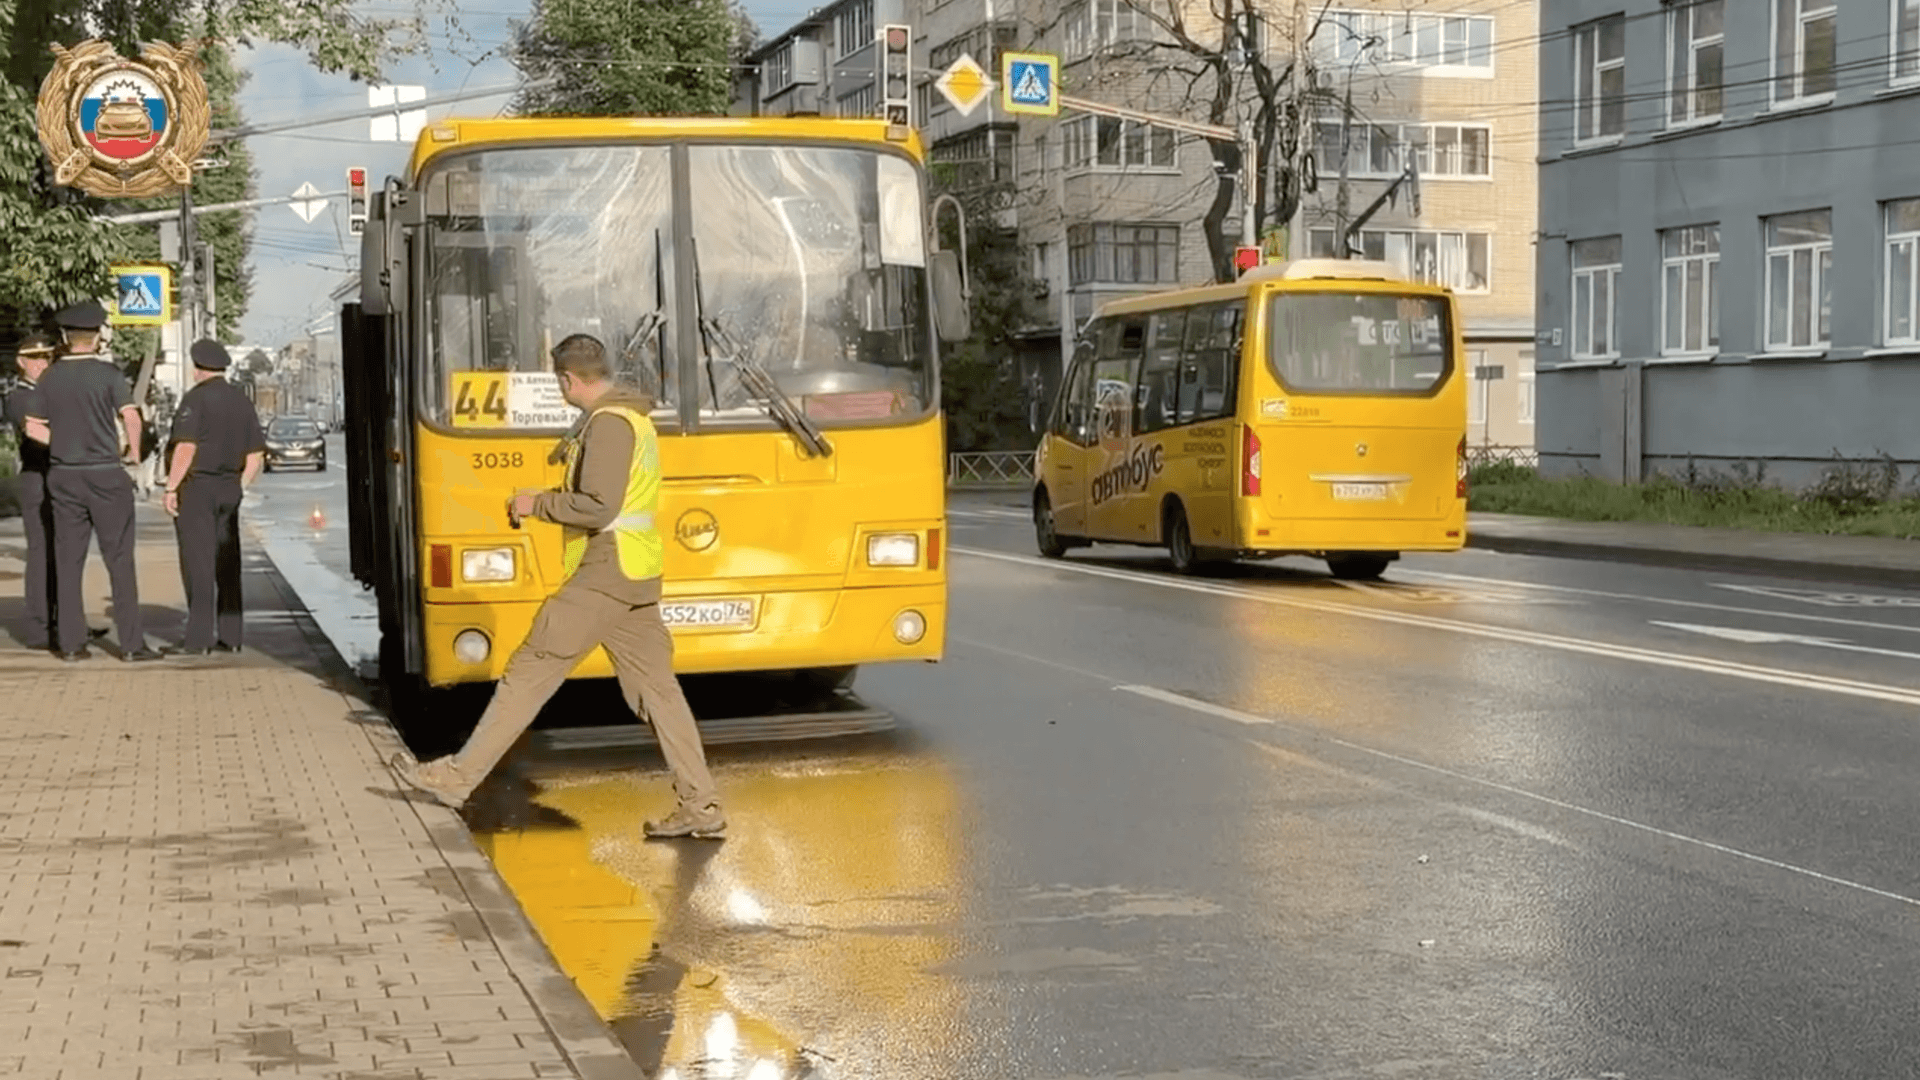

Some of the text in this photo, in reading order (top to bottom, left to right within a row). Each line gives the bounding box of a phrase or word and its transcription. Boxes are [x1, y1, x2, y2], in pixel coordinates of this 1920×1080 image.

[455, 380, 507, 421] 44
[512, 410, 568, 424] Торговый
[472, 452, 524, 468] 3038
[1091, 443, 1165, 506] автобус
